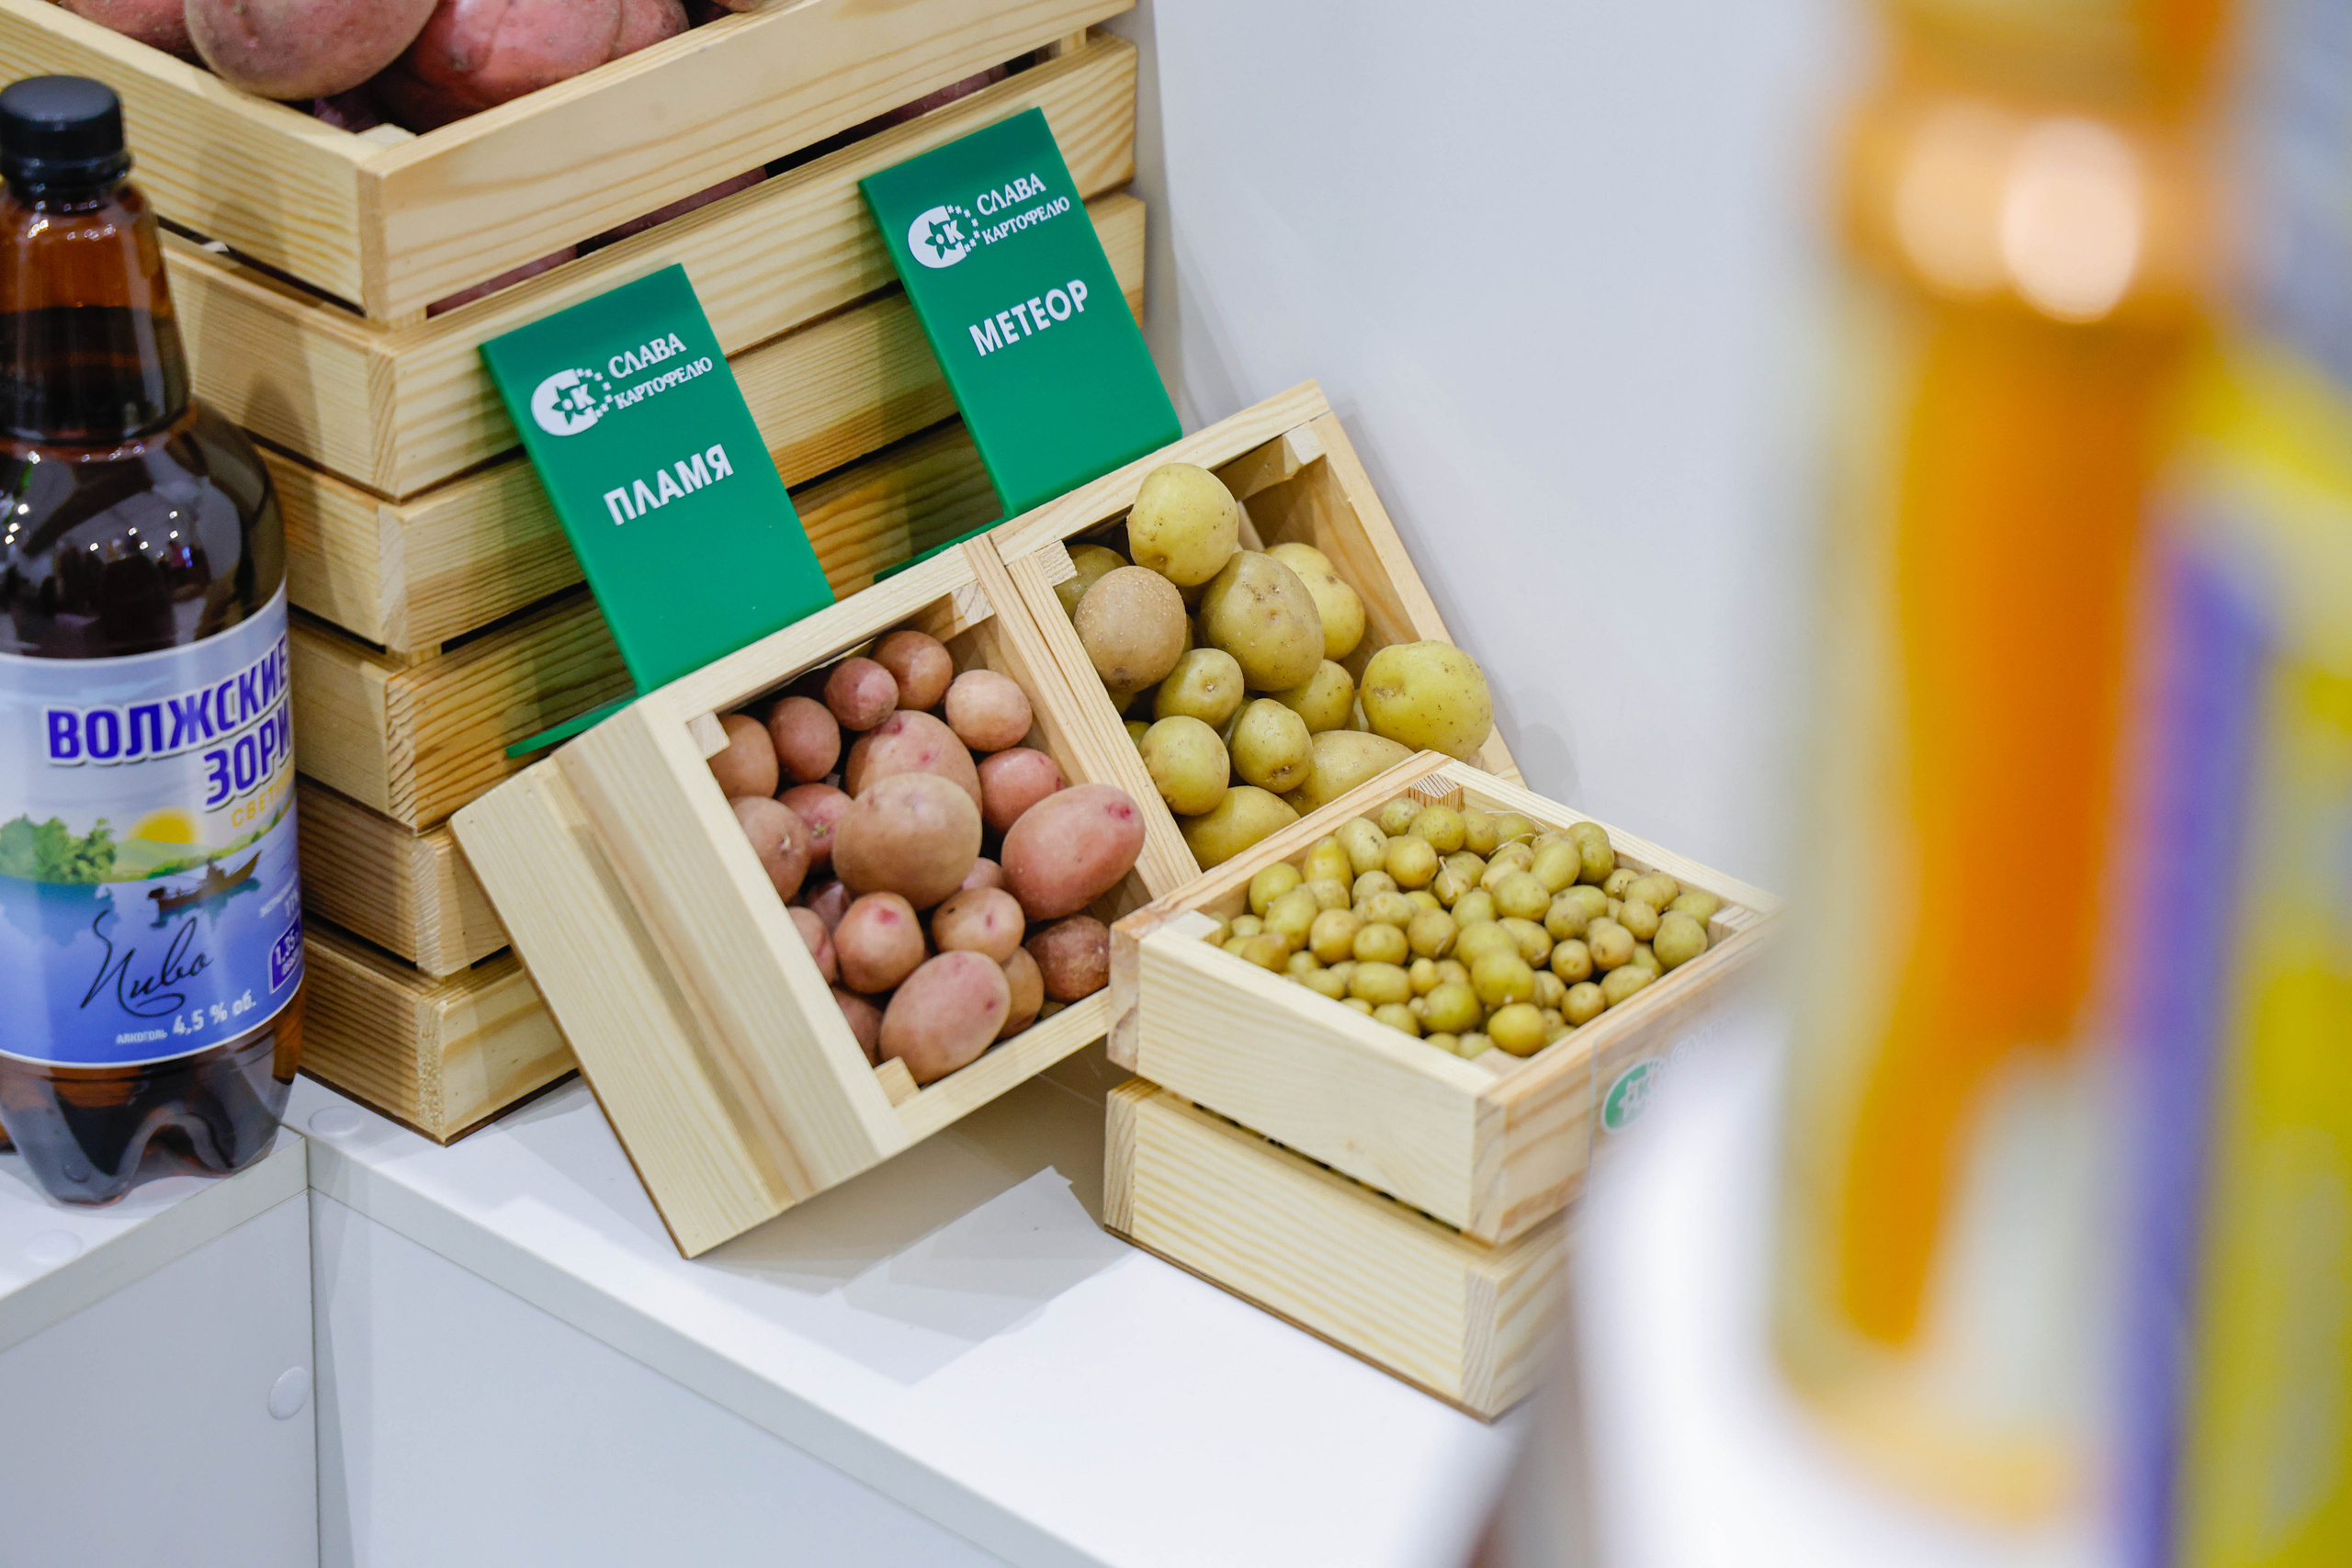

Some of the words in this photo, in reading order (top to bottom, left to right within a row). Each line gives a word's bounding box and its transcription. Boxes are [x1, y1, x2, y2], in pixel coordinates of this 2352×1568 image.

[976, 172, 1047, 216] СЛАВА
[980, 196, 1071, 245] КАРТОФЕЛЮ
[967, 278, 1089, 357] МЕТЕОР
[606, 332, 687, 379] СЛАВА
[613, 355, 714, 411] КАРТОФЕЛЮ
[602, 443, 735, 526] ПЛАМЯ
[45, 630, 289, 761] ВОЛЖСКИЕ
[204, 696, 292, 807] ЗОРИ
[80, 908, 215, 1019] Пиво
[116, 1028, 169, 1046] АЛКОГОЛЬ
[172, 1008, 205, 1036] 4,5
[209, 1000, 229, 1026] %
[232, 988, 257, 1017] об.
